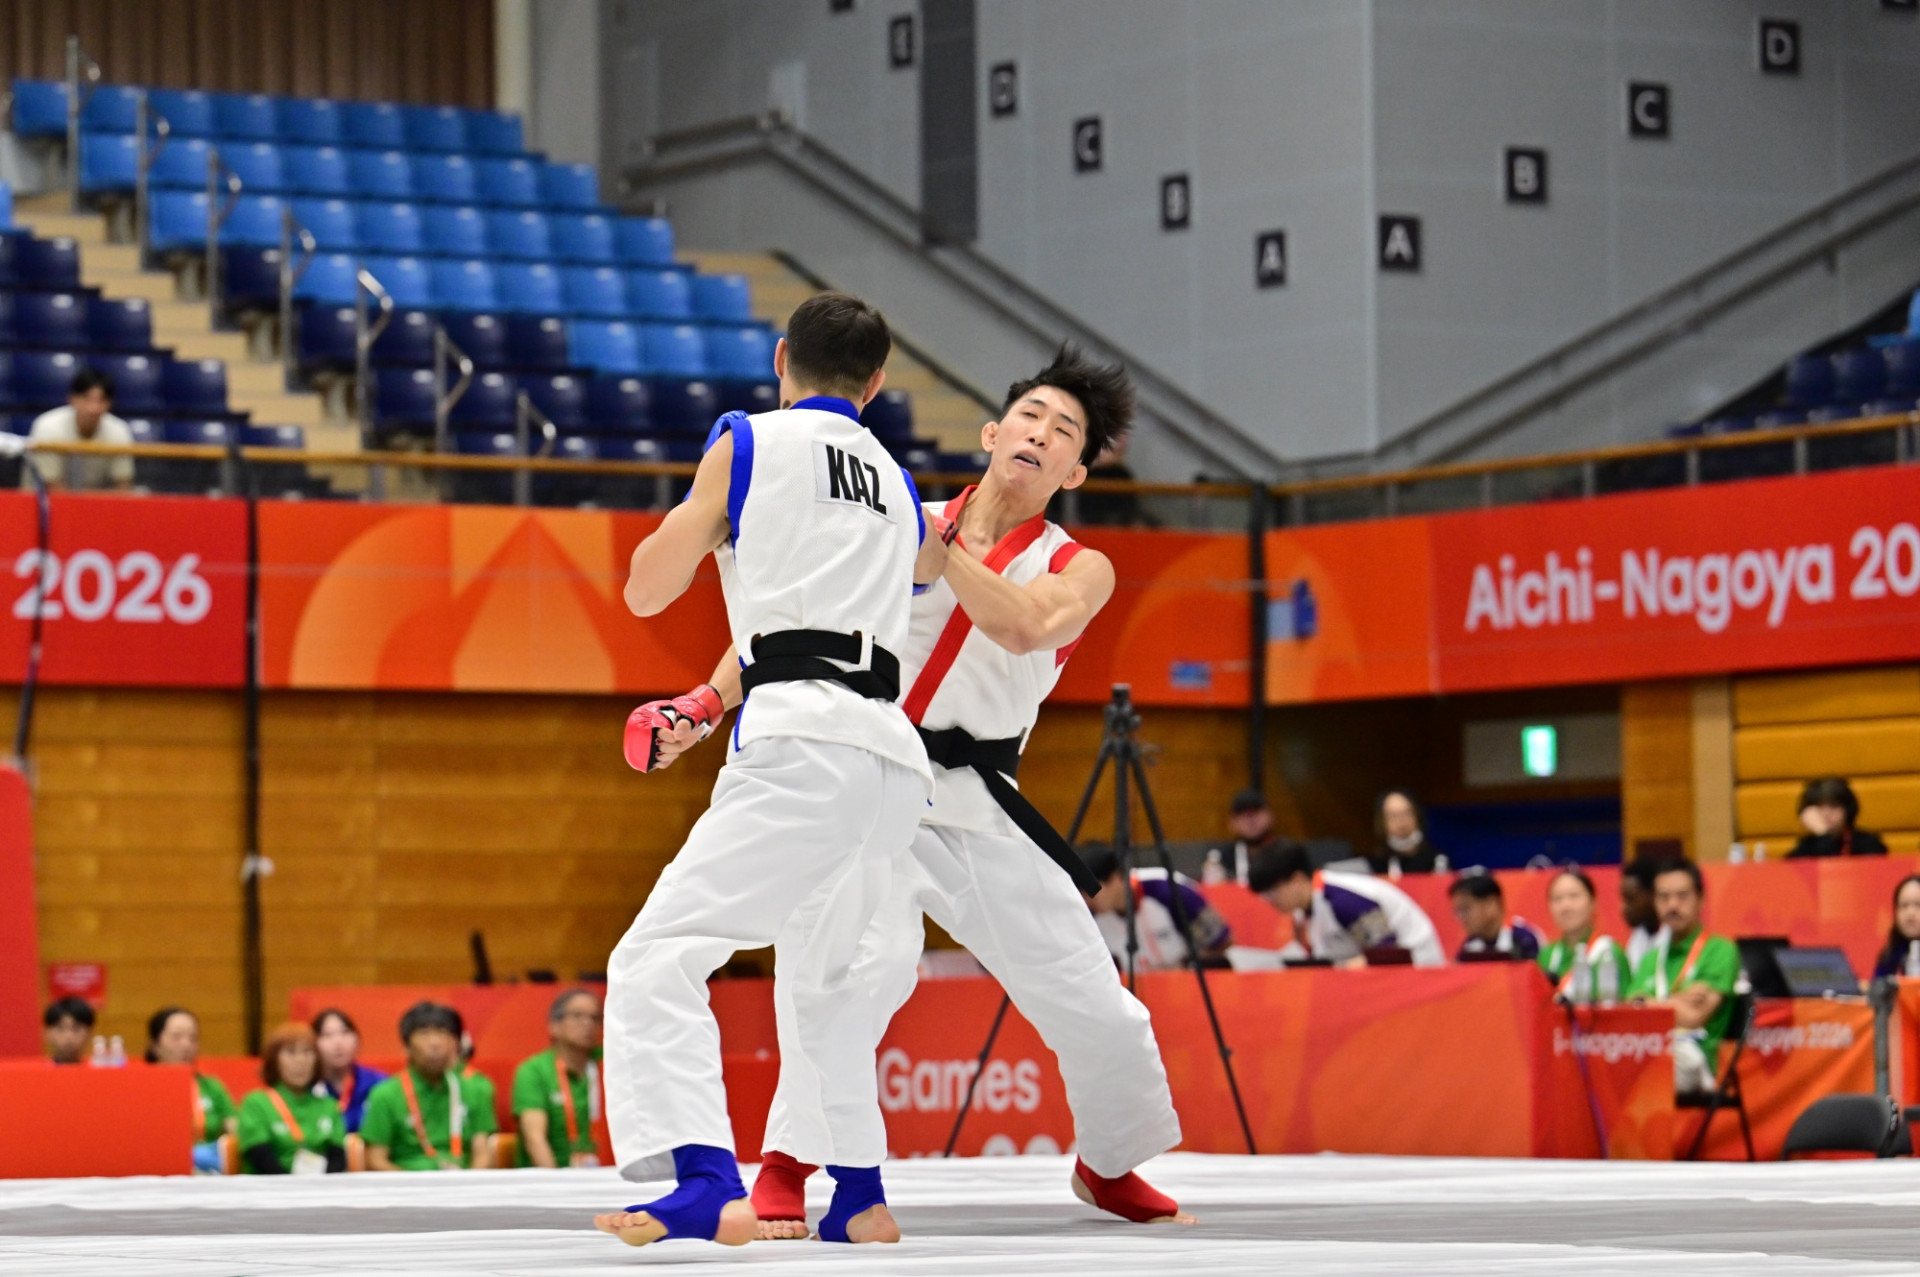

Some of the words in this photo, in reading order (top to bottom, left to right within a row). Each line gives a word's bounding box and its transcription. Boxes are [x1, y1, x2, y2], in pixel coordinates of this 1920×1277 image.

[1765, 27, 1794, 66] D
[1633, 89, 1661, 130] C
[1076, 124, 1099, 163] C
[1512, 155, 1539, 196] B
[1259, 238, 1283, 276] A
[1383, 221, 1415, 262] A
[826, 444, 887, 516] KAZ
[13, 547, 213, 624] 2026
[1464, 545, 1835, 633] Aichi-Nagoya
[1849, 522, 1920, 600] 20
[878, 1047, 1042, 1114] Games
